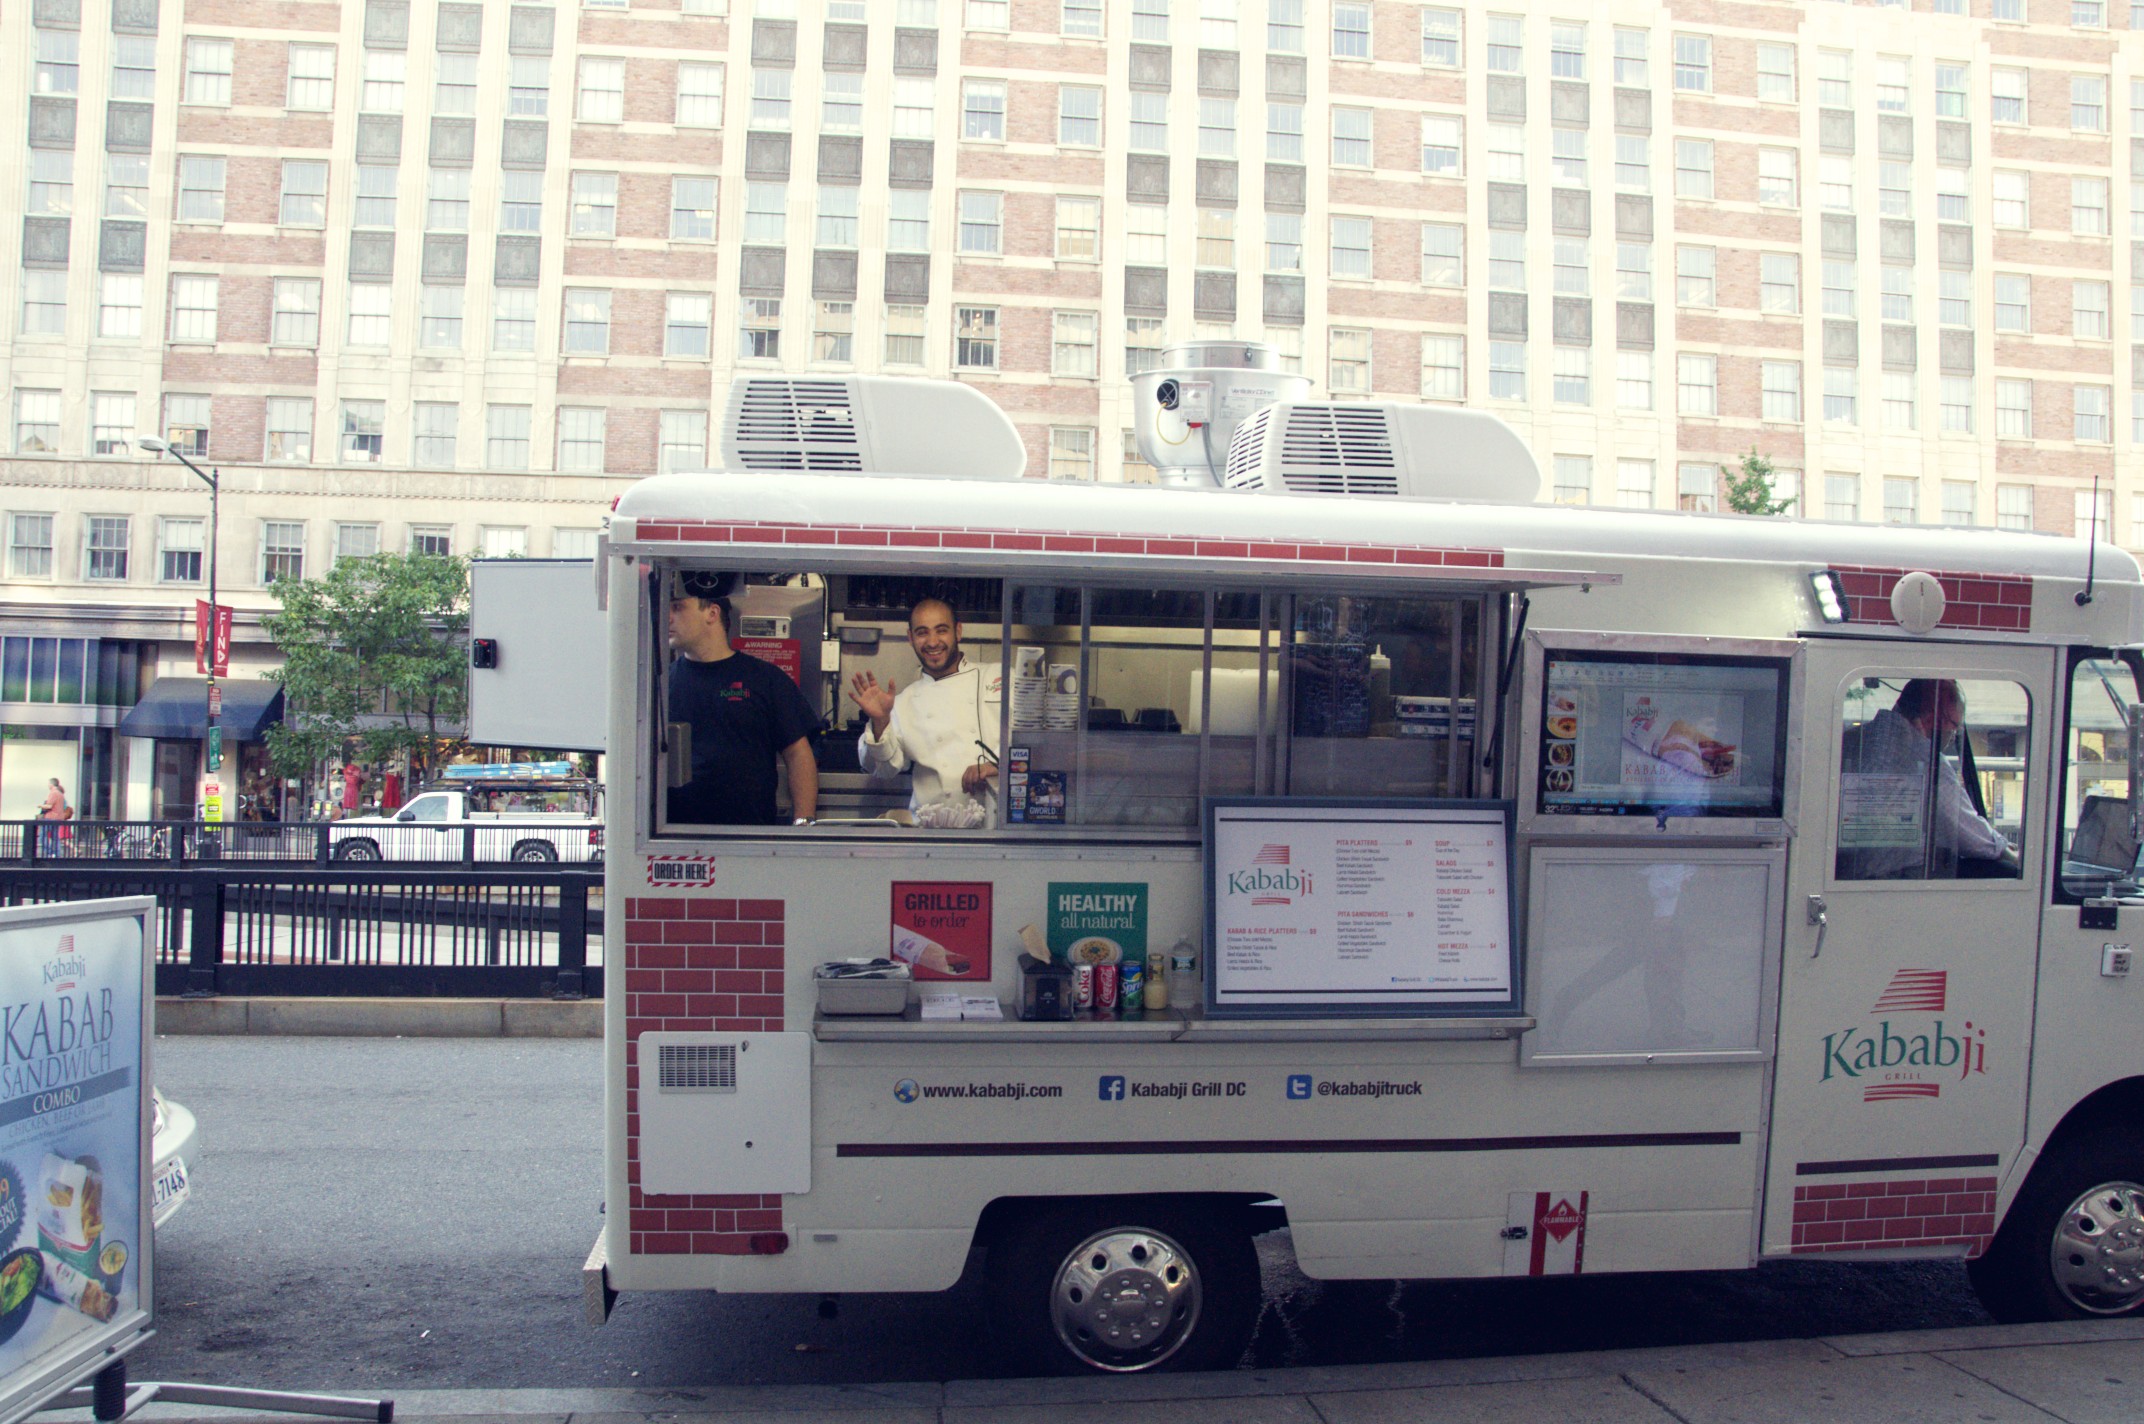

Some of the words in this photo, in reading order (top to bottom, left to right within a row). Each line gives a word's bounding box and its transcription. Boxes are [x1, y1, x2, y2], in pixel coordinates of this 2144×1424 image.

[217, 611, 227, 663] FIND
[1029, 806, 1056, 815] GWORLD
[654, 862, 683, 880] ORDER
[685, 863, 707, 880] HERE
[1228, 868, 1315, 897] Kababji
[904, 893, 979, 911] GRILLED
[1058, 894, 1138, 912] HEALTHY
[913, 912, 926, 928] to
[930, 912, 969, 928] order
[1060, 912, 1080, 929] all
[1081, 912, 1136, 929] natural
[43, 955, 86, 984] Kababji
[2, 987, 114, 1066] KABAB
[1818, 1020, 1986, 1083] Kababji
[2, 1041, 111, 1100] SANDWICH
[1884, 1072, 1922, 1081] GRILL
[923, 1083, 1063, 1100] www.kababji.com
[1131, 1082, 1187, 1100] Kababji
[1191, 1082, 1222, 1097] Grill
[1226, 1082, 1247, 1097] DC
[1317, 1081, 1423, 1099] @kababjitruck
[33, 1085, 81, 1114] COMBO
[1543, 1216, 1579, 1224] FLAMMABLE
